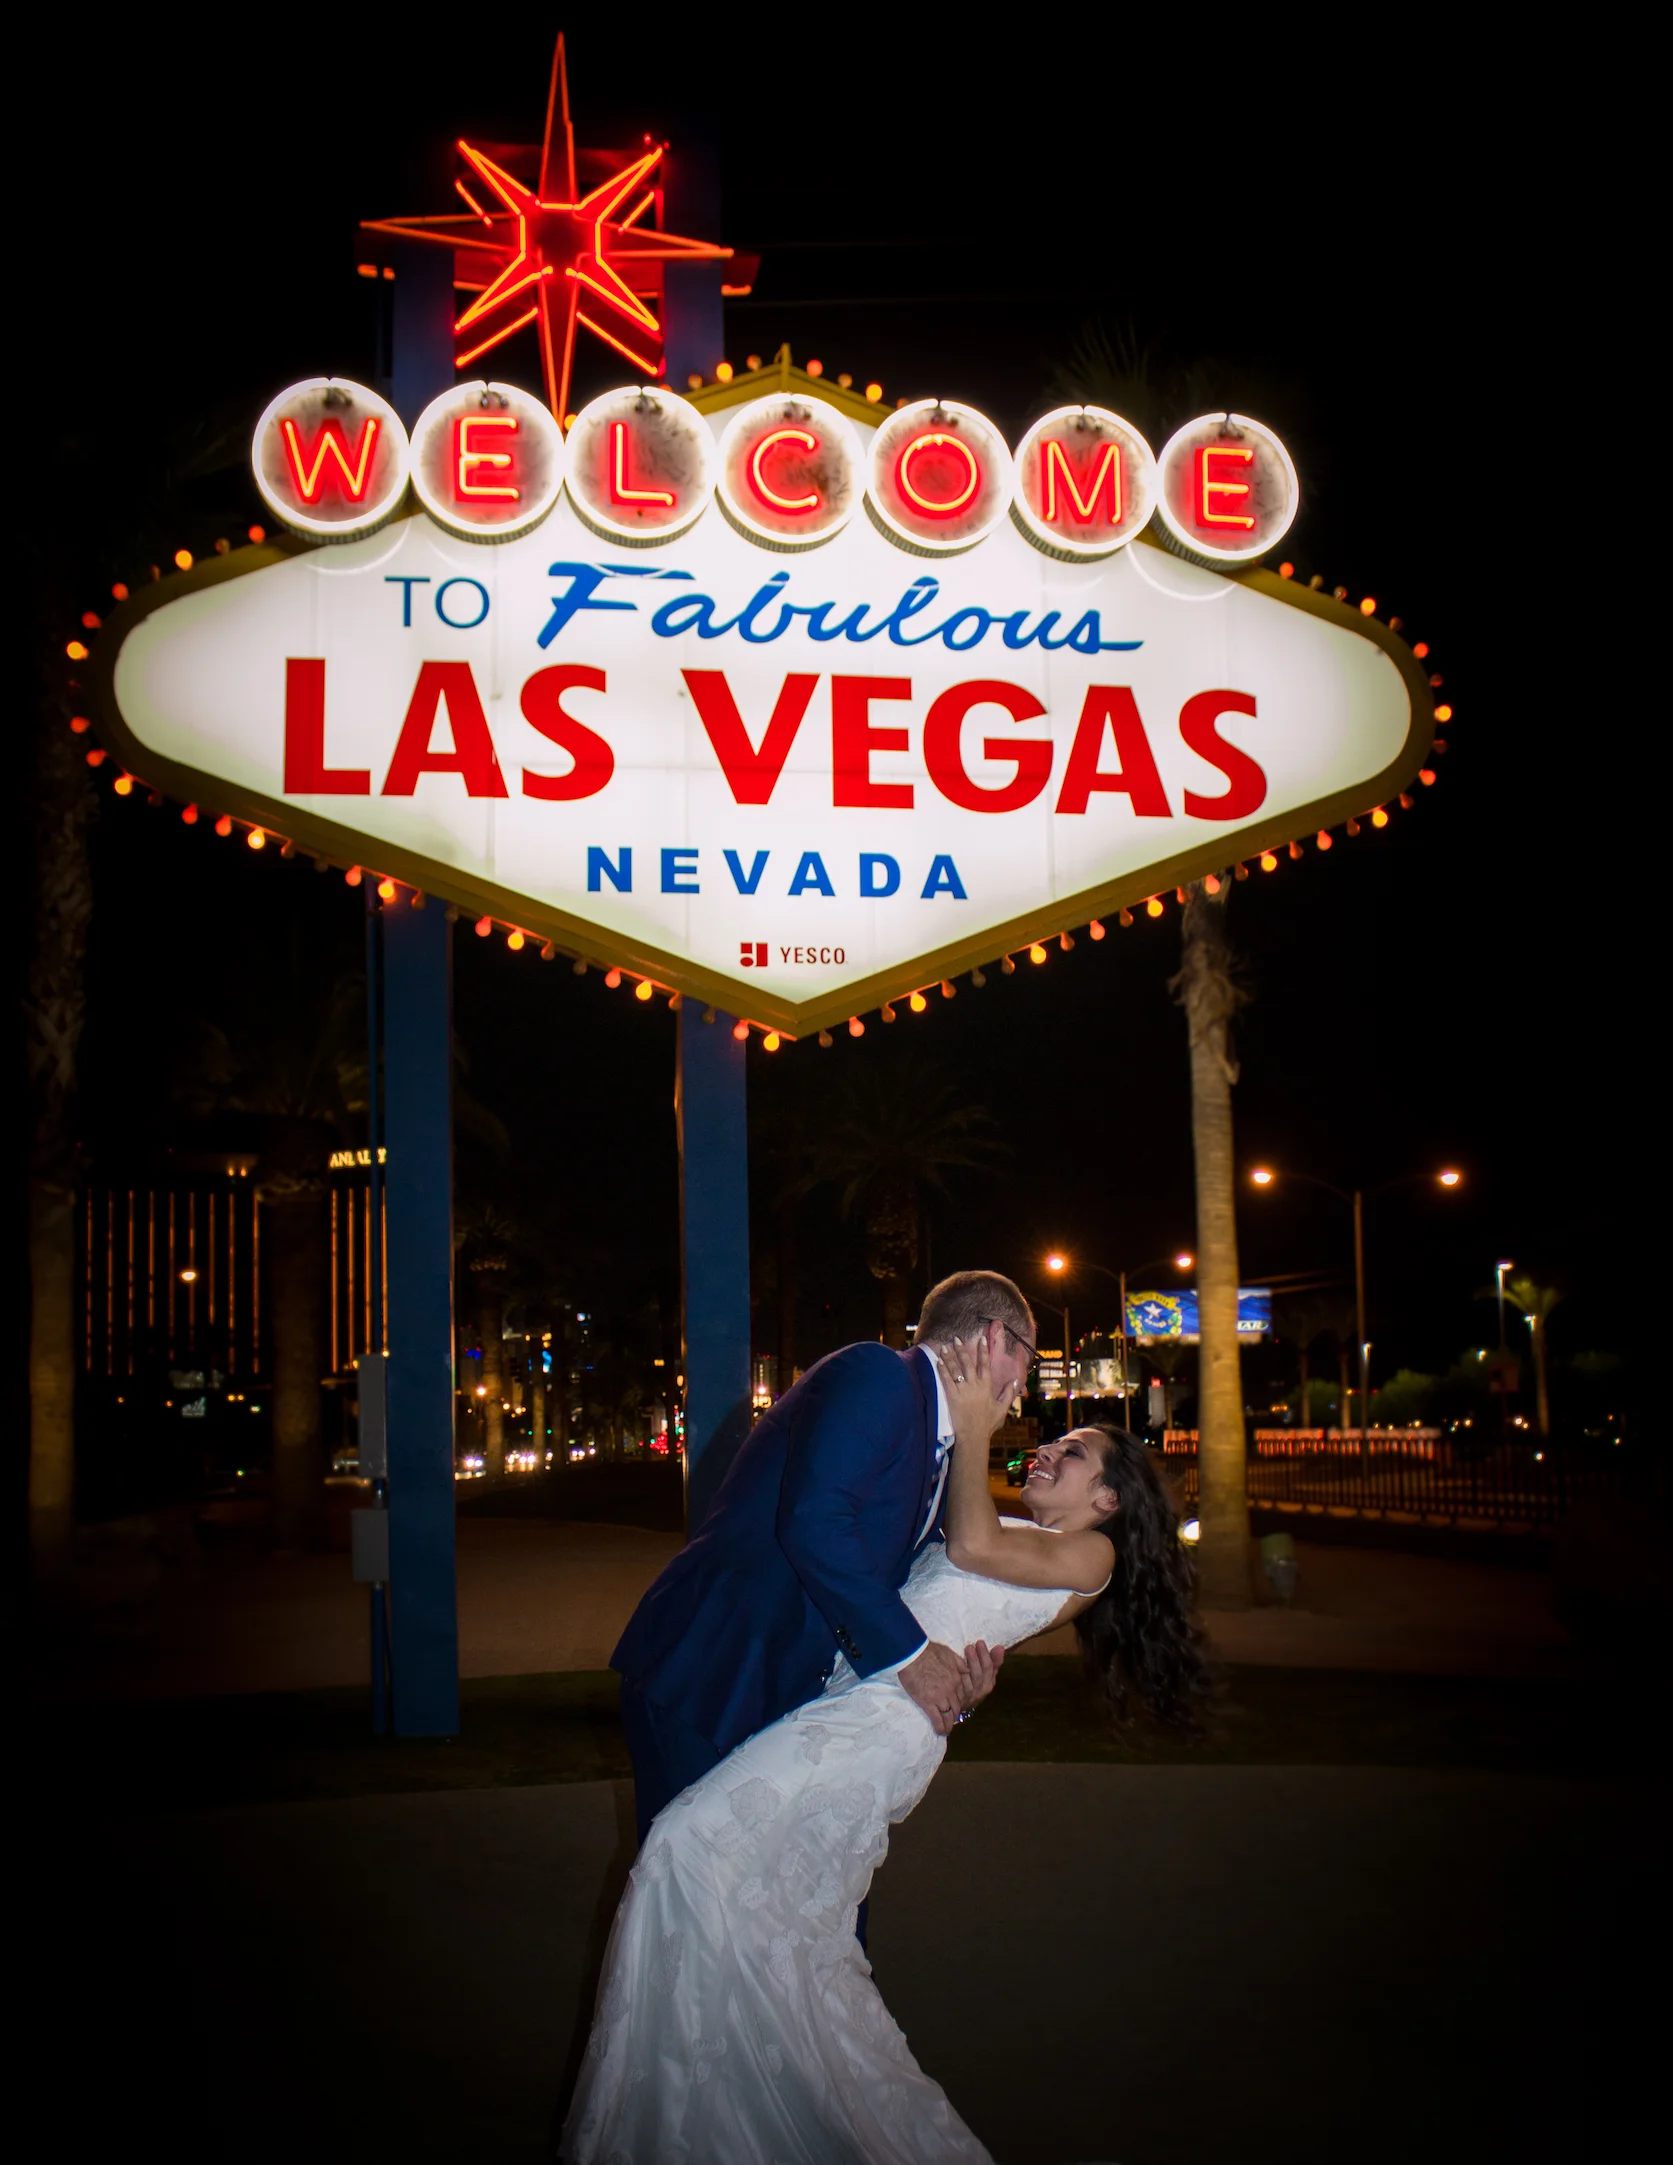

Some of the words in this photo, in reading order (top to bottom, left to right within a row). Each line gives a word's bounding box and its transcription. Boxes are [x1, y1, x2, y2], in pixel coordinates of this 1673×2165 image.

[282, 416, 1255, 529] WELCOME
[385, 575, 491, 629] TO
[537, 562, 1144, 654] Fabulous
[283, 657, 616, 800] LAS
[680, 669, 1268, 821] VEGAS
[587, 847, 969, 900] NEVADA
[780, 947, 845, 964] YESCO
